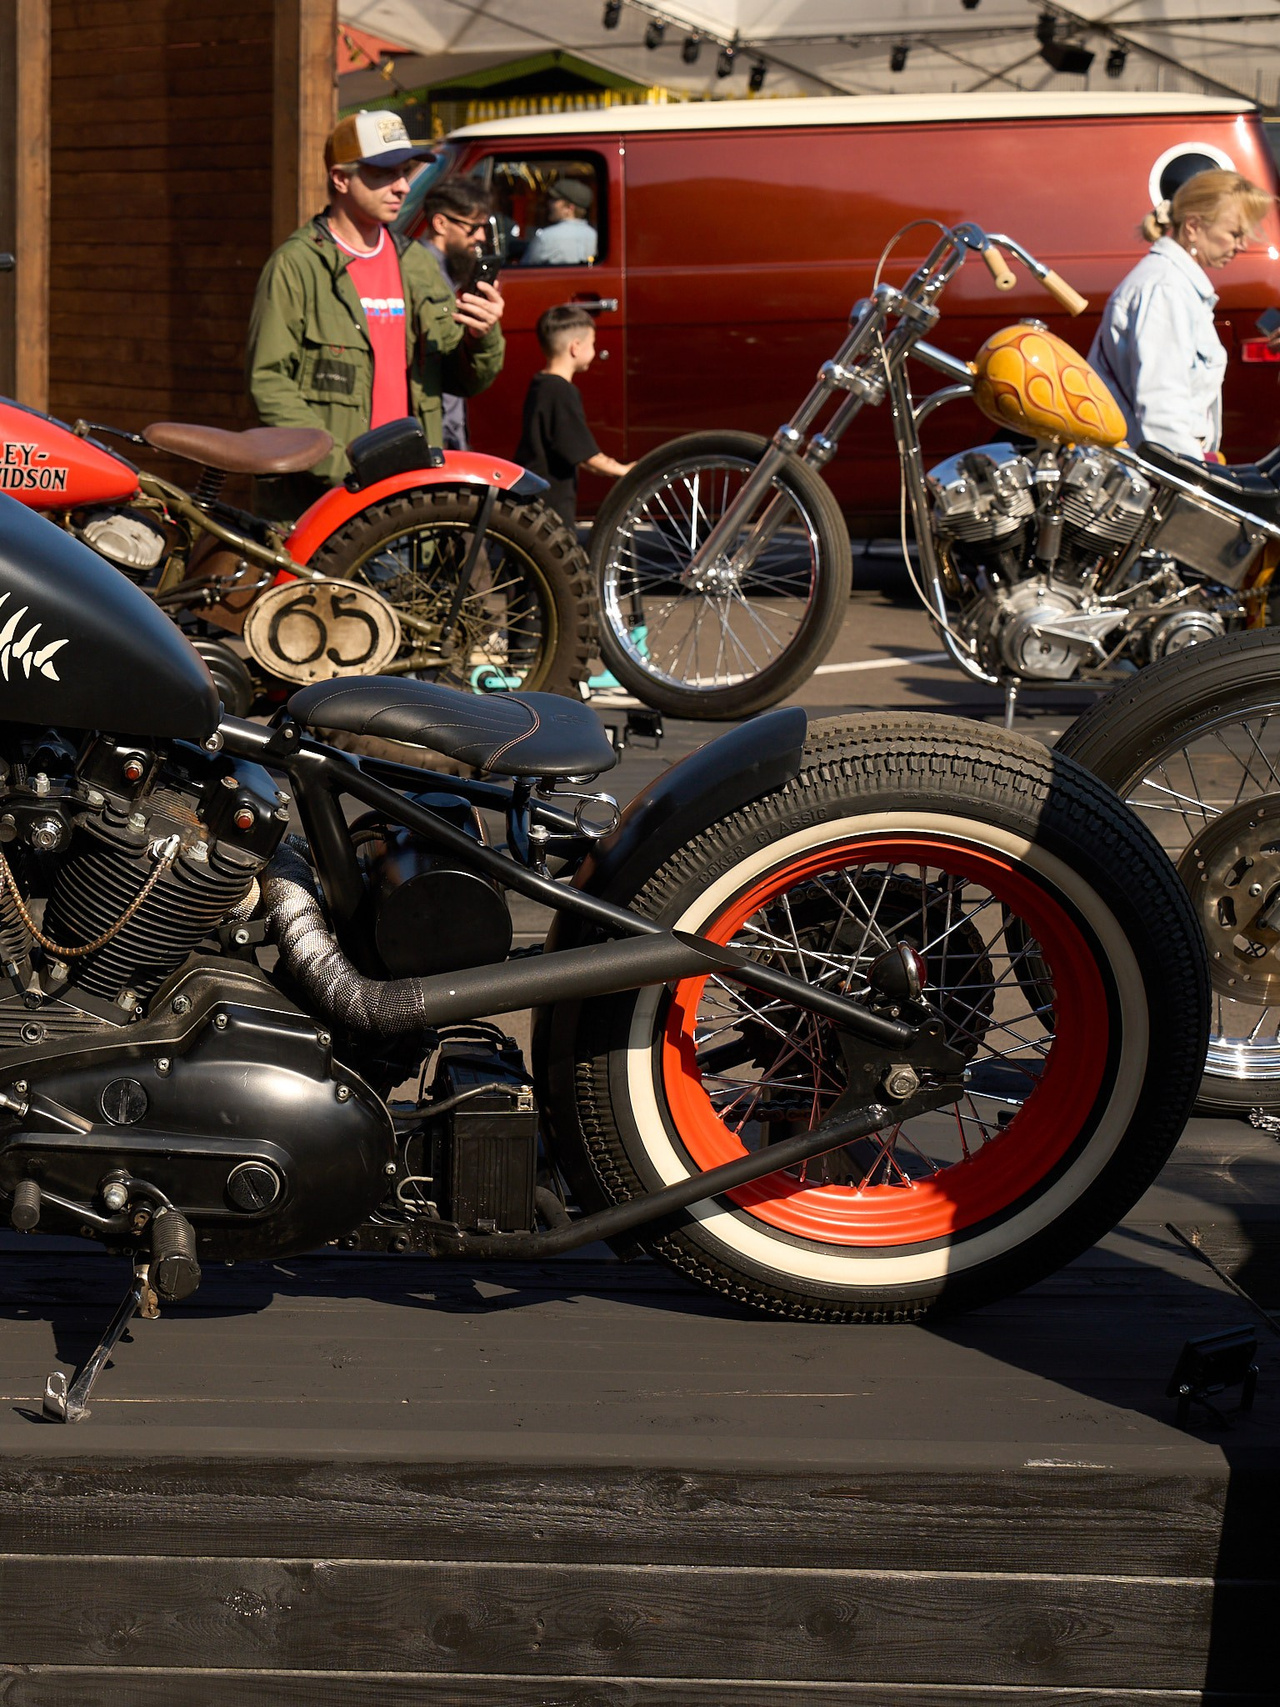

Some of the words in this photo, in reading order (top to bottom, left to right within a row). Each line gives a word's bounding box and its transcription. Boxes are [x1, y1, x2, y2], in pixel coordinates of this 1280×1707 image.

[268, 593, 379, 667] 65
[697, 844, 747, 884] COKER
[754, 807, 828, 845] CLASSIC
